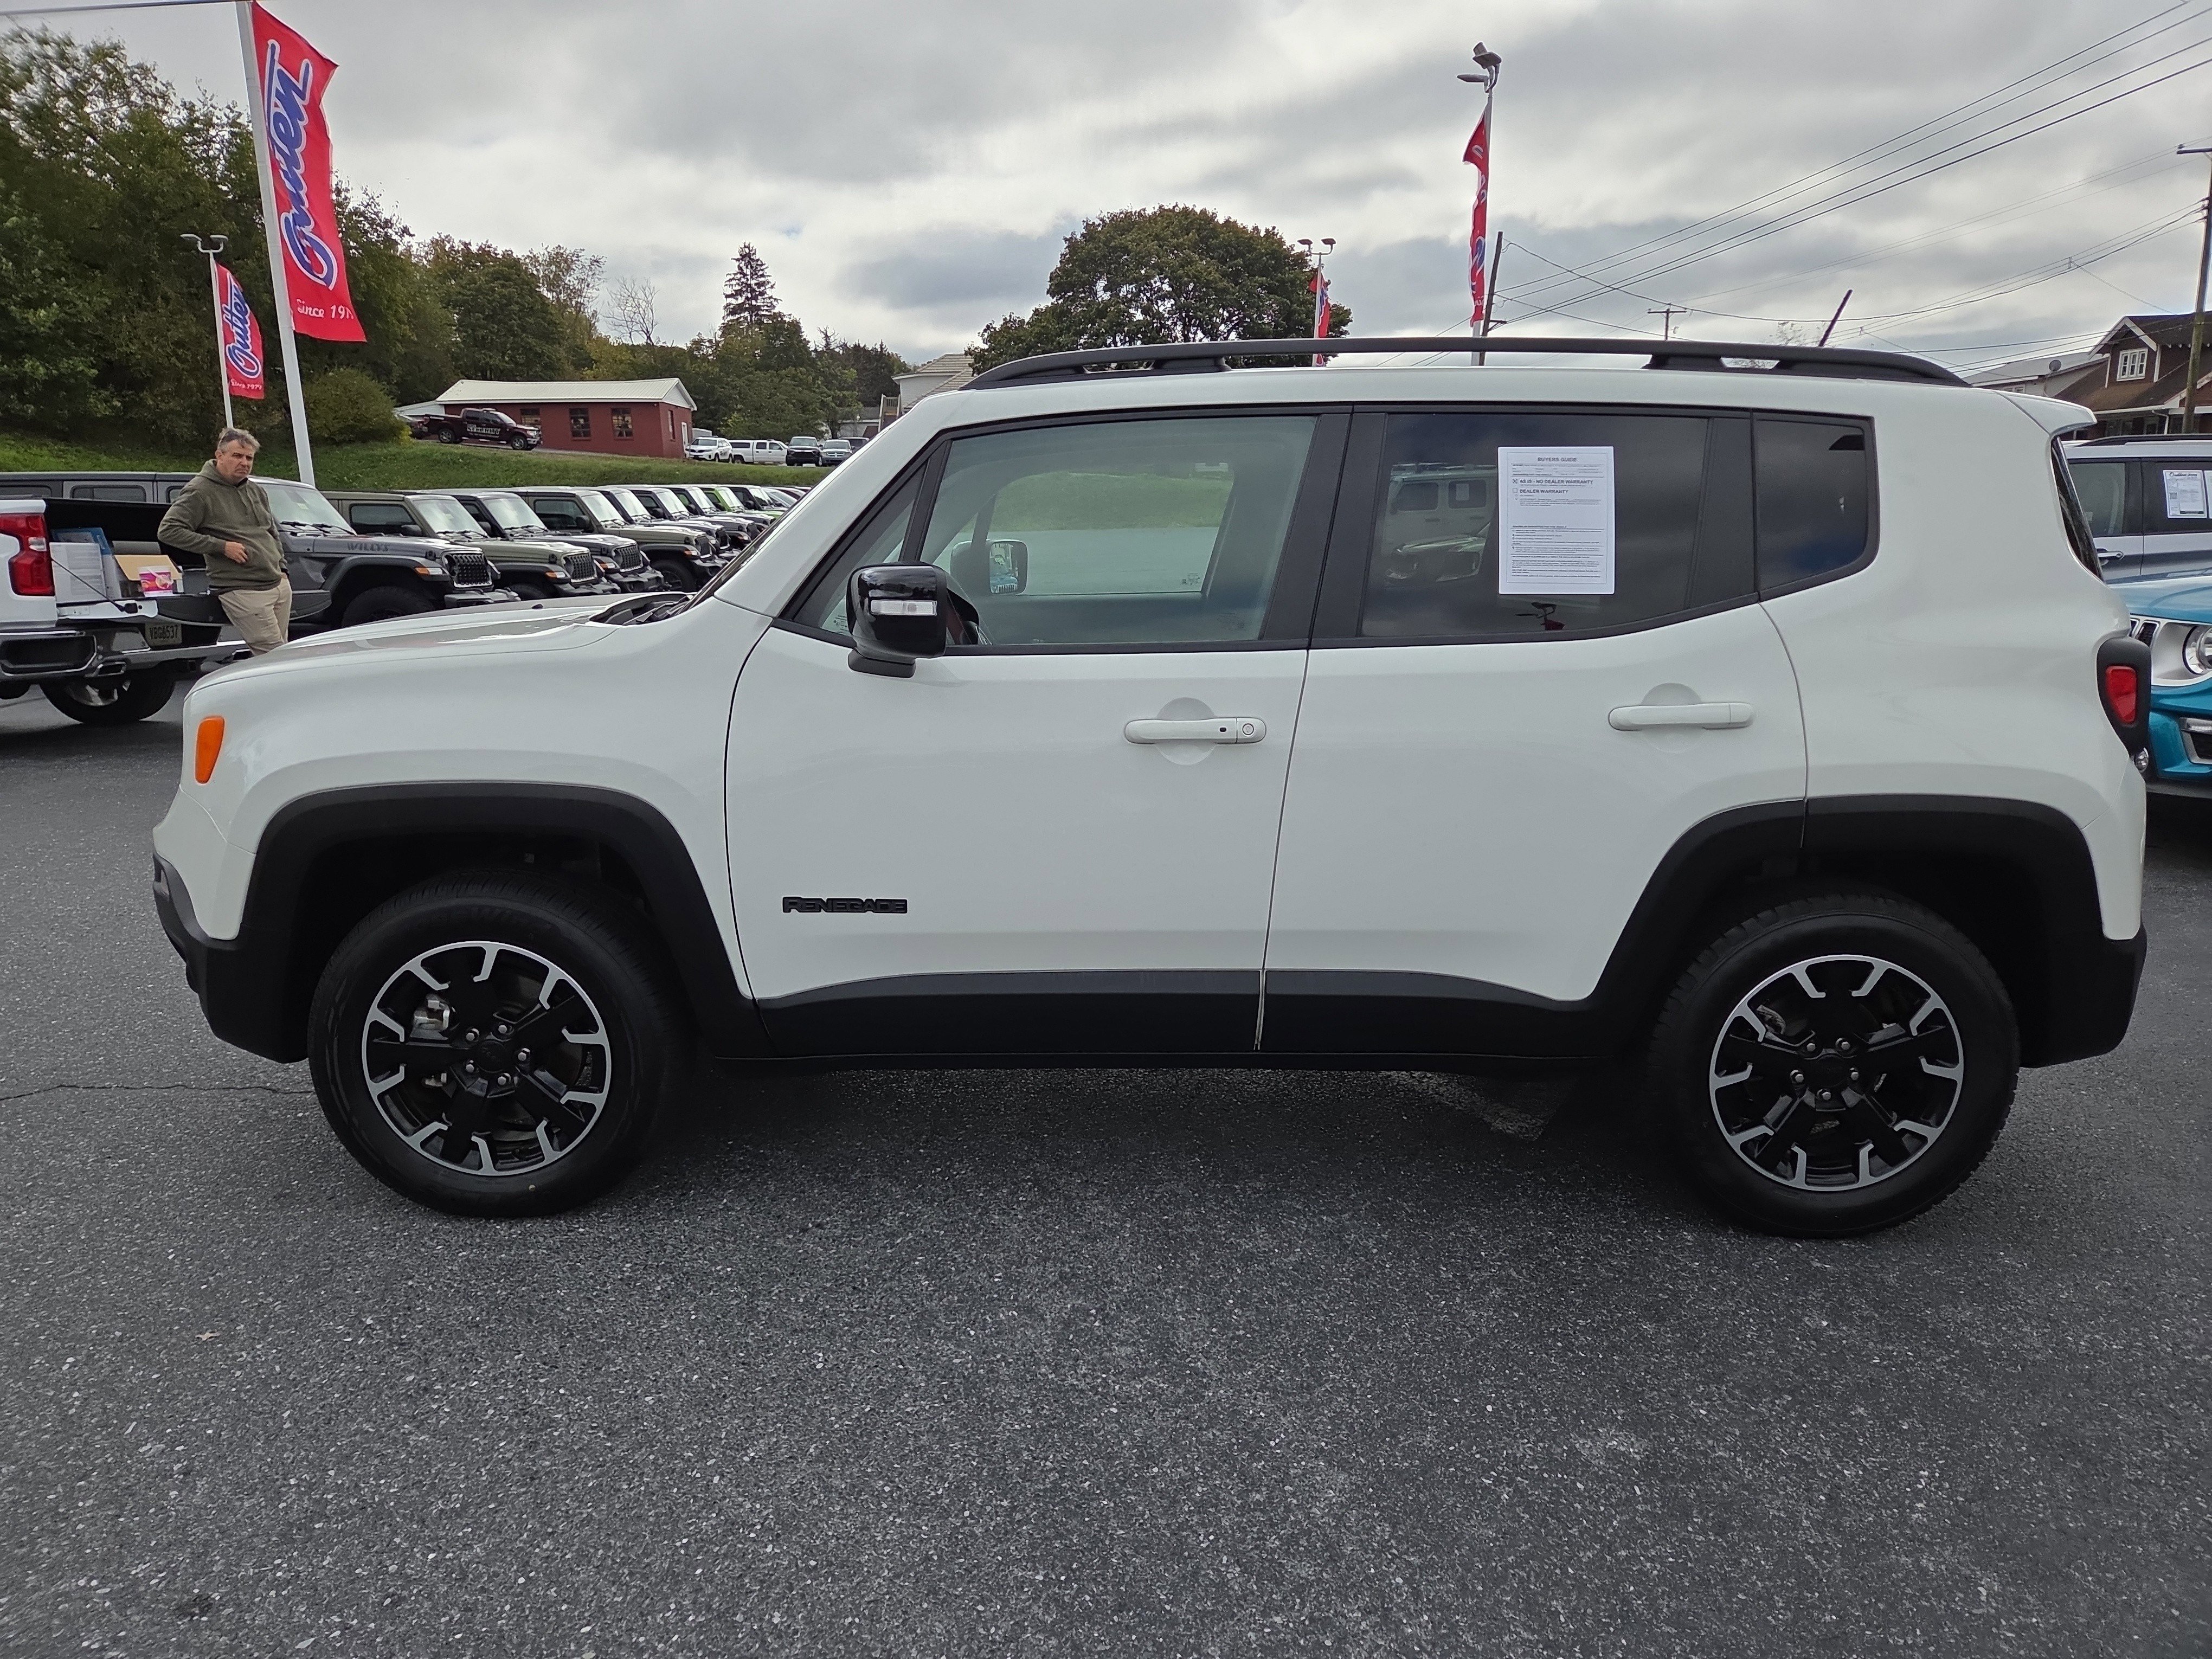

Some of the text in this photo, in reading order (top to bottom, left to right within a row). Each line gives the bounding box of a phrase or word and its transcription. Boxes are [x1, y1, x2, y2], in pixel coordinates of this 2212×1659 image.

[296, 298, 325, 318] Since
[347, 543, 390, 552] WILLYS
[782, 896, 908, 914] RENEGADE
